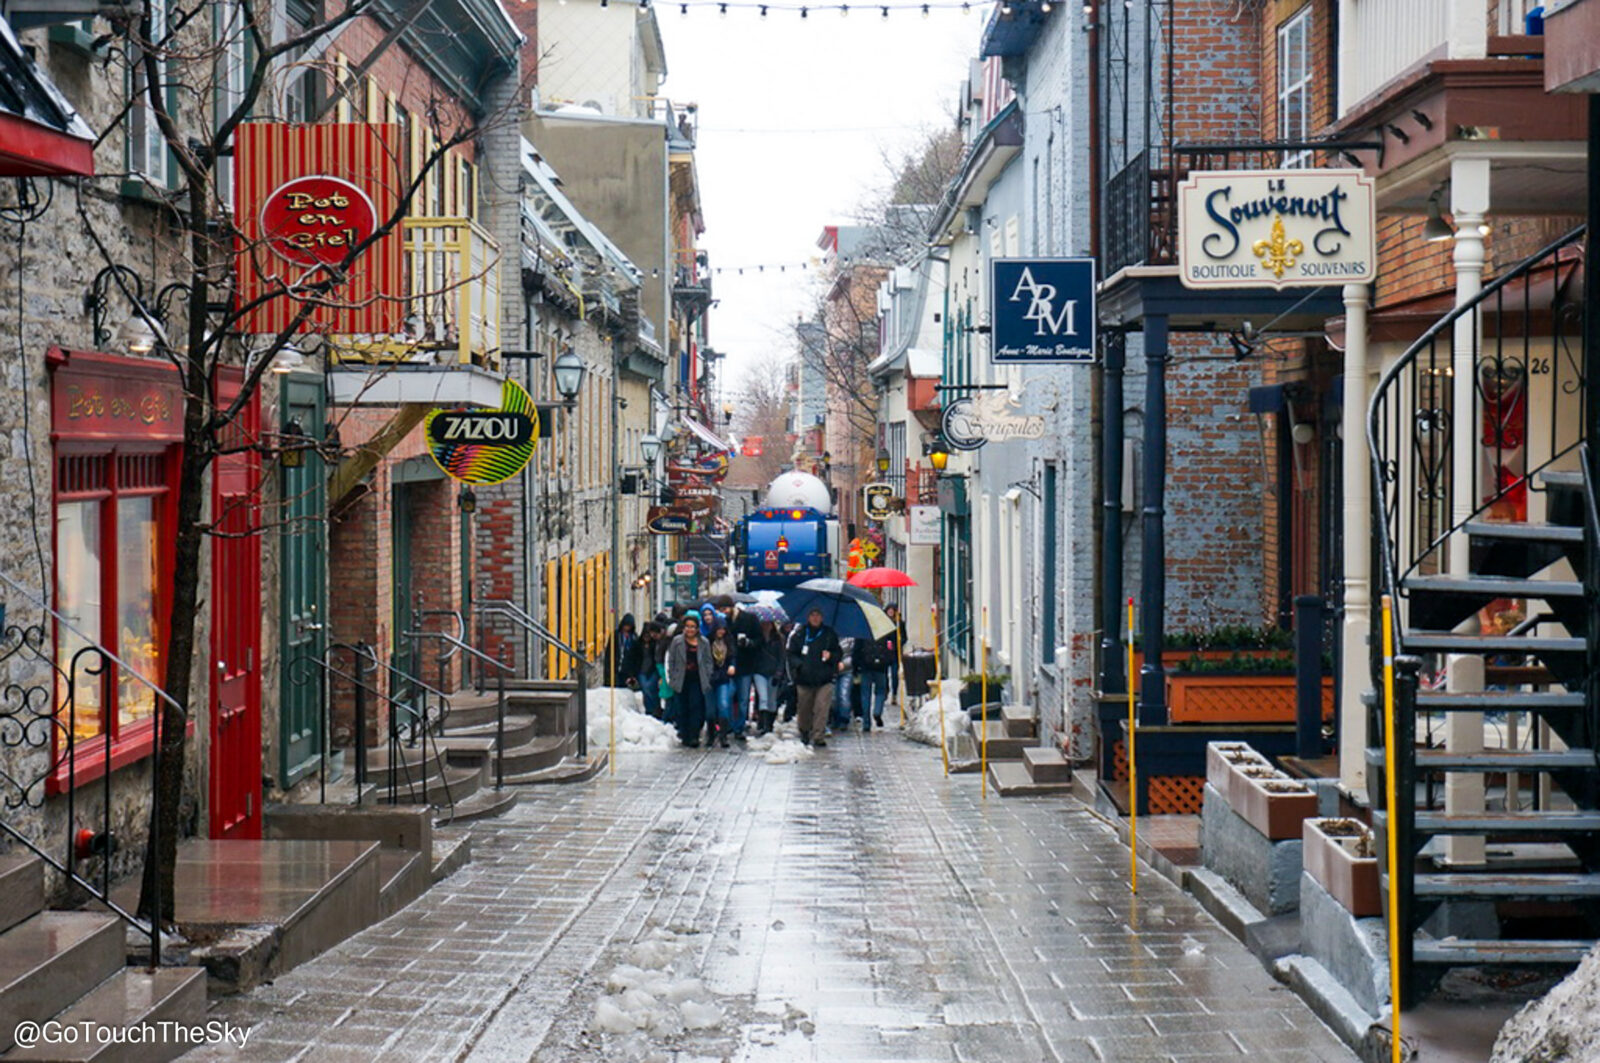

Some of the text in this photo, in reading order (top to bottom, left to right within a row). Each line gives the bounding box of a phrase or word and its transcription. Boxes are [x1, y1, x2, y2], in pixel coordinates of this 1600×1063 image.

[1268, 179, 1285, 192] LE
[284, 191, 350, 210] Pot
[299, 213, 346, 225] en
[286, 228, 357, 249] Ciel
[1192, 261, 1366, 279] BOUTIQUE SOUVENIRS
[1055, 343, 1094, 358] Boutique
[1531, 357, 1550, 374] 26
[66, 384, 105, 420] Pot
[444, 417, 518, 439] ZAZOU
